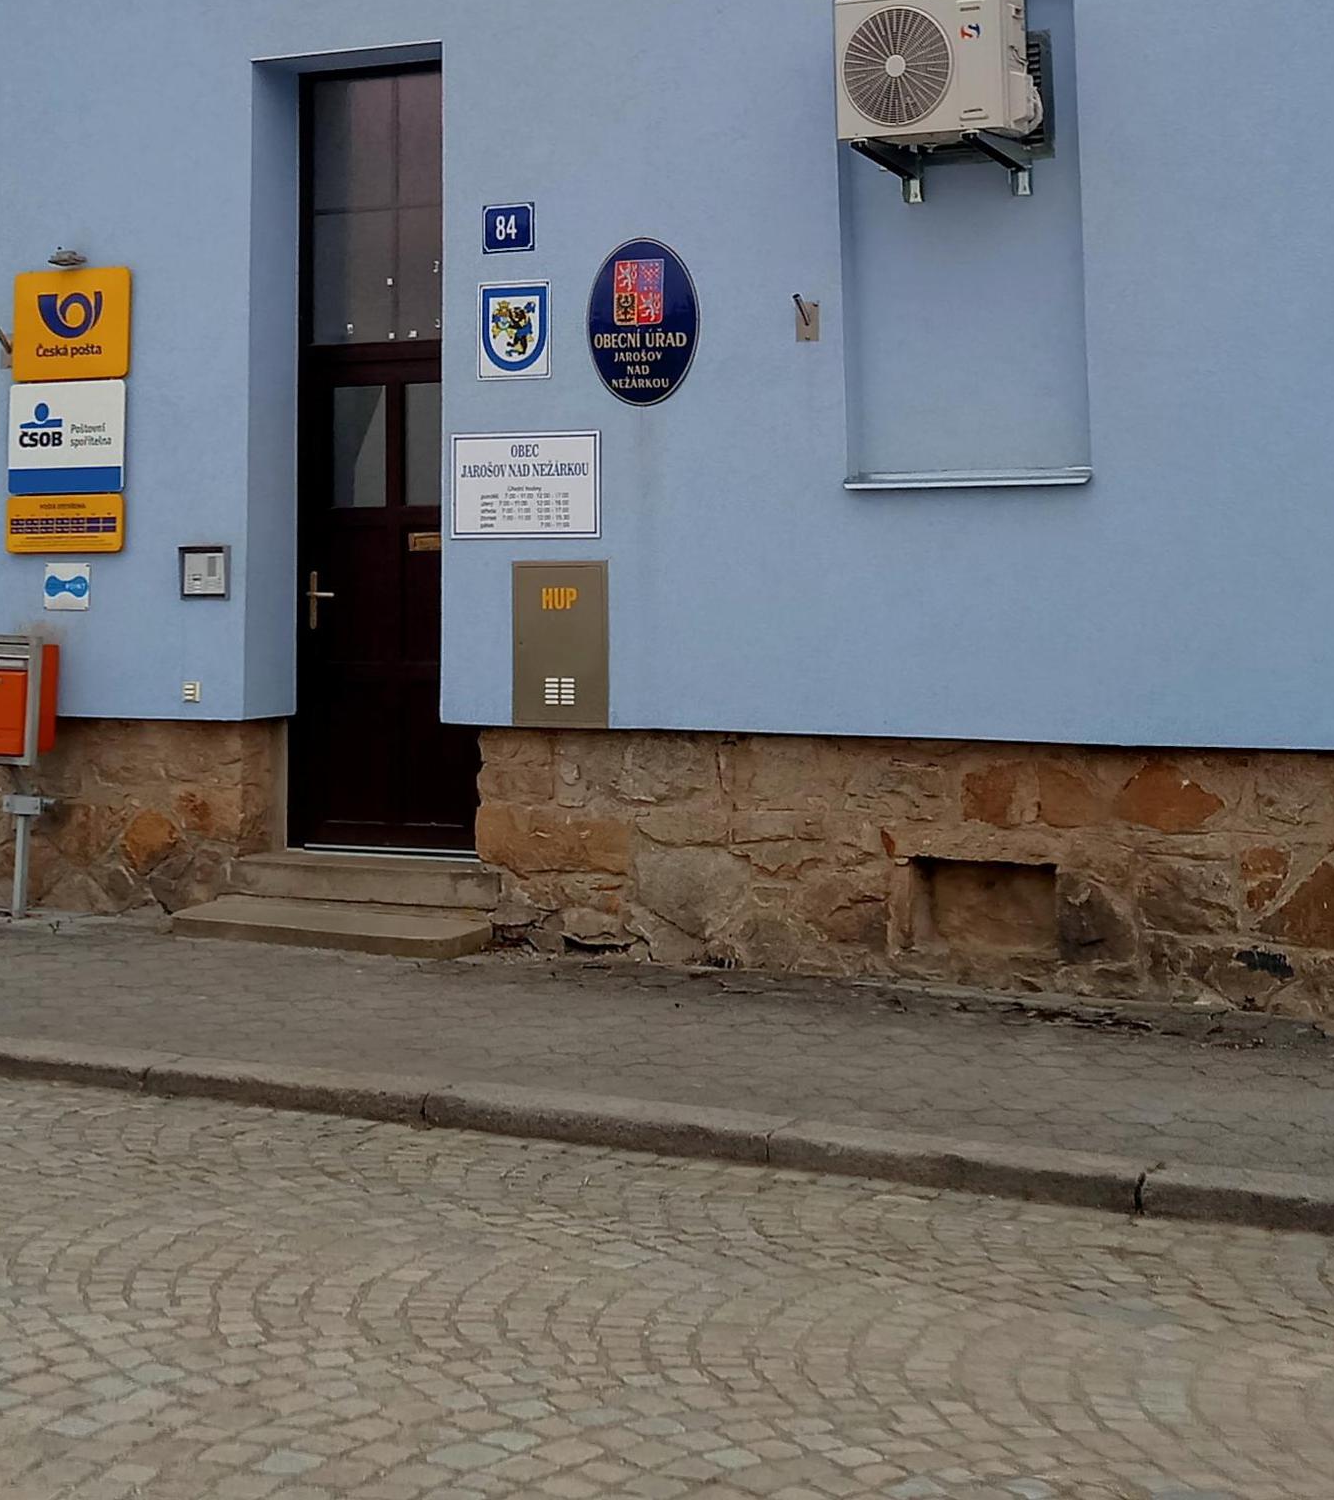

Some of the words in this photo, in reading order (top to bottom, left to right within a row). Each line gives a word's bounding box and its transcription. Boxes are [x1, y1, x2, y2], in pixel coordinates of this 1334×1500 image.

[496, 214, 517, 240] 84
[594, 328, 640, 348] OBECNÍ
[646, 328, 687, 348] ÚŘAD
[36, 343, 69, 357] Česká
[70, 343, 102, 358] pošta
[614, 349, 662, 362] JAROŠOV
[627, 365, 650, 375] NAD
[611, 376, 670, 388] NEŽÁRKOU
[19, 431, 63, 447] ČSOB
[510, 444, 540, 458] OBEC
[461, 461, 507, 478] JAROŠOV
[508, 463, 530, 477] NAD
[532, 460, 589, 476] NEŽÁRKOU
[541, 587, 578, 609] HUP
